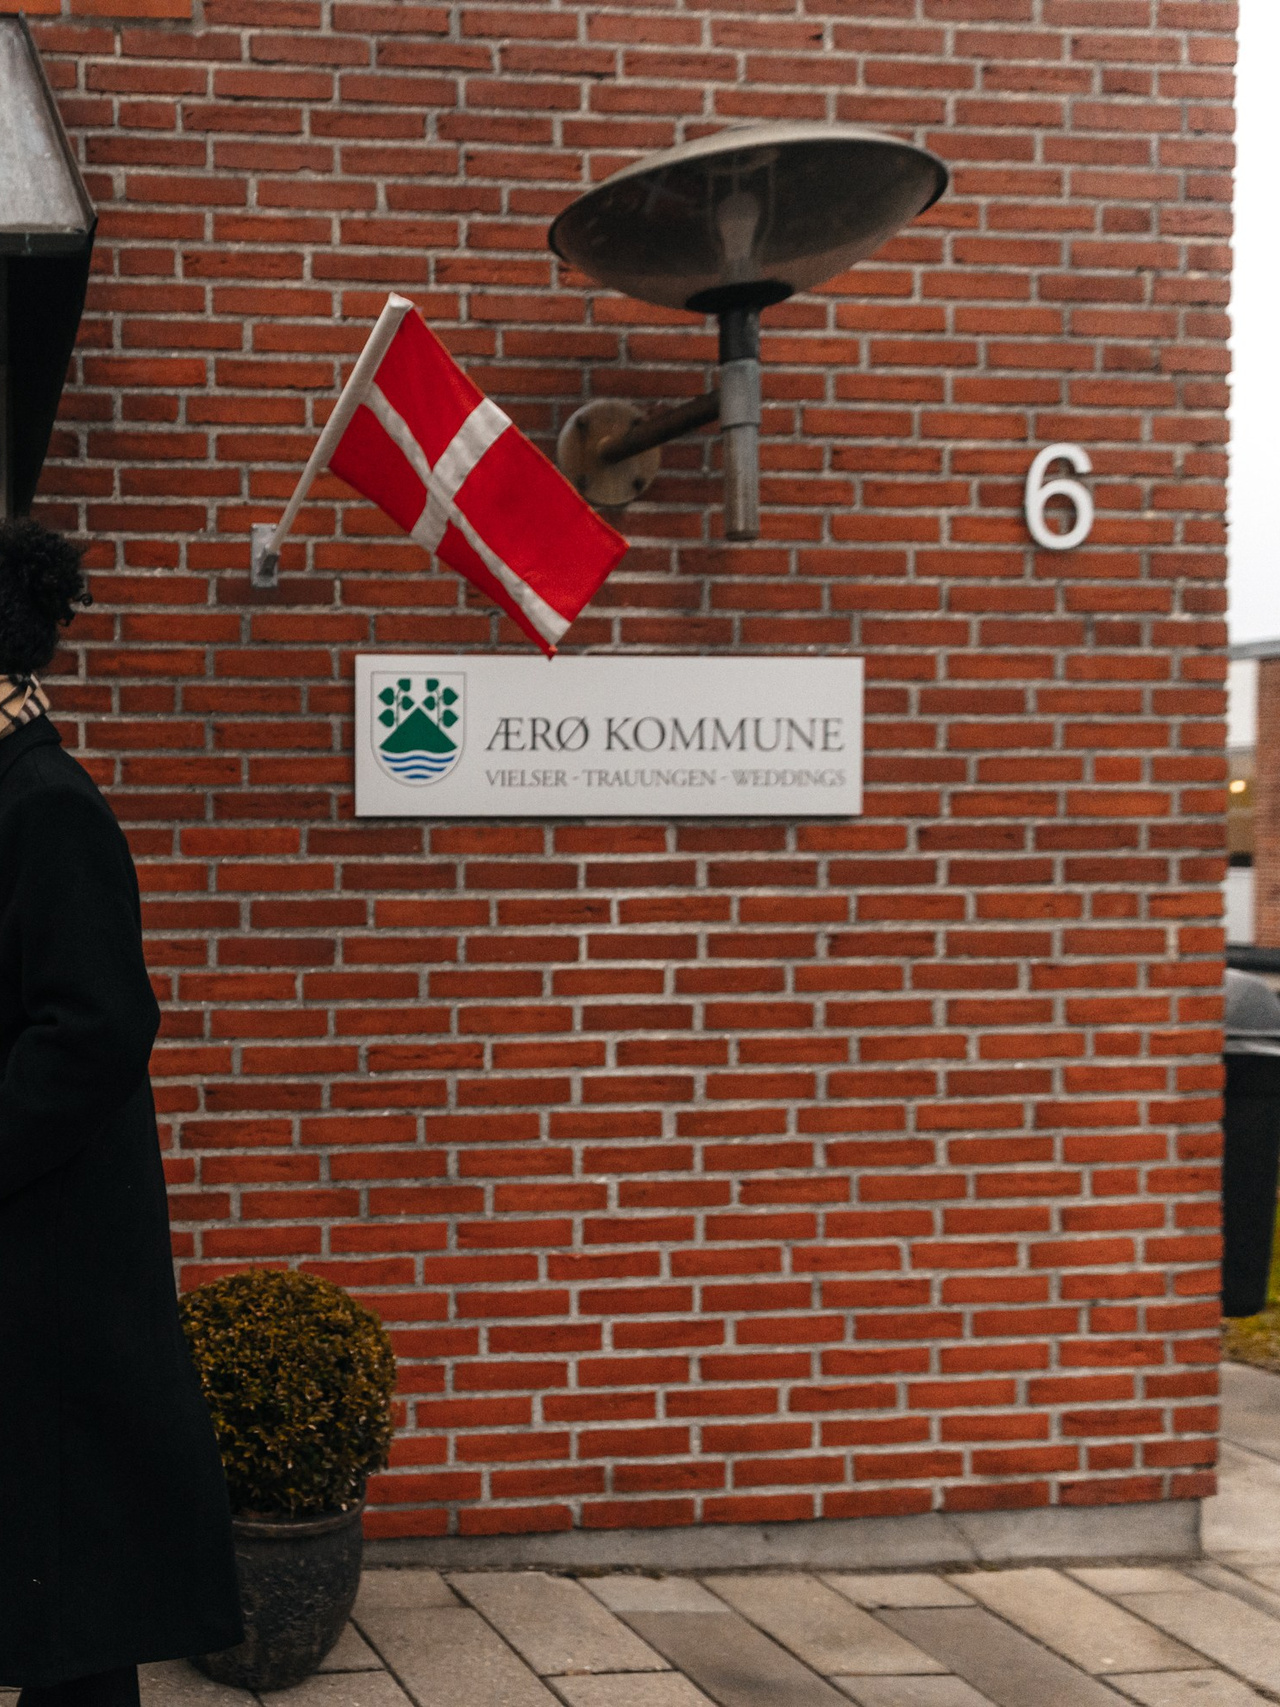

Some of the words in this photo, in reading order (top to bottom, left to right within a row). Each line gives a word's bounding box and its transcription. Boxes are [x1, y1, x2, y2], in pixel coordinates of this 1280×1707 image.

[1025, 443, 1095, 550] 6
[485, 716, 590, 751] ÆRØ
[605, 716, 845, 752] KOMMUNE
[485, 769, 568, 787] VIELSER
[582, 769, 717, 787] TRAUUNGEN
[731, 769, 847, 787] WEDDINGS
